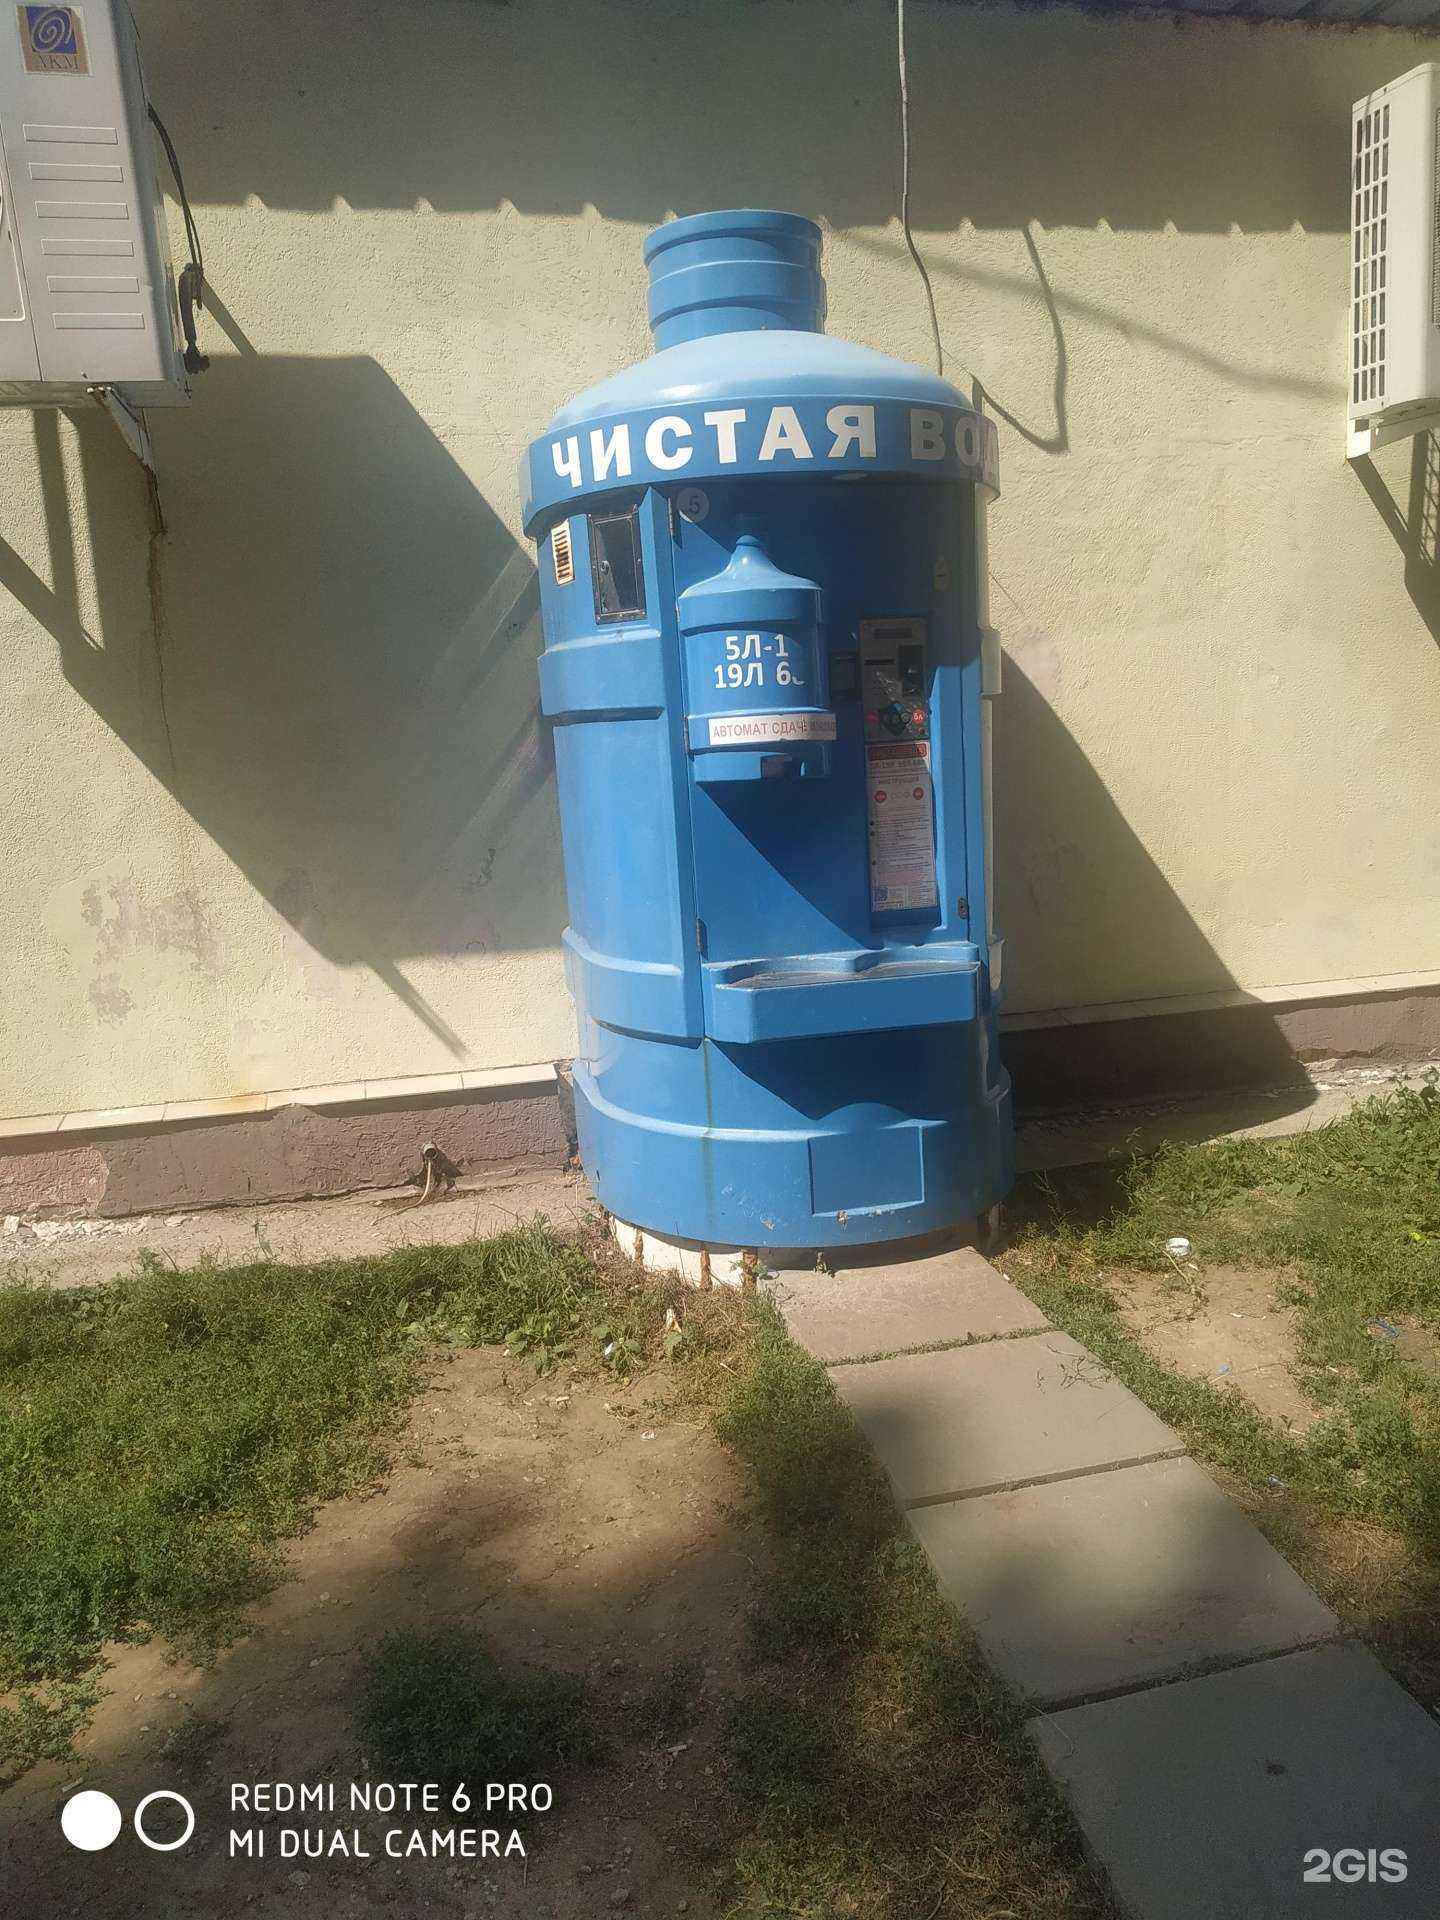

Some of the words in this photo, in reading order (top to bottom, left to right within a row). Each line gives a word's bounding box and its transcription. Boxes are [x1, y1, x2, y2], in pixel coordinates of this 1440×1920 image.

[551, 404, 877, 488] ЧИСТАЯ
[714, 662, 765, 689] 19Л
[713, 722, 770, 738] АВТОМАТ
